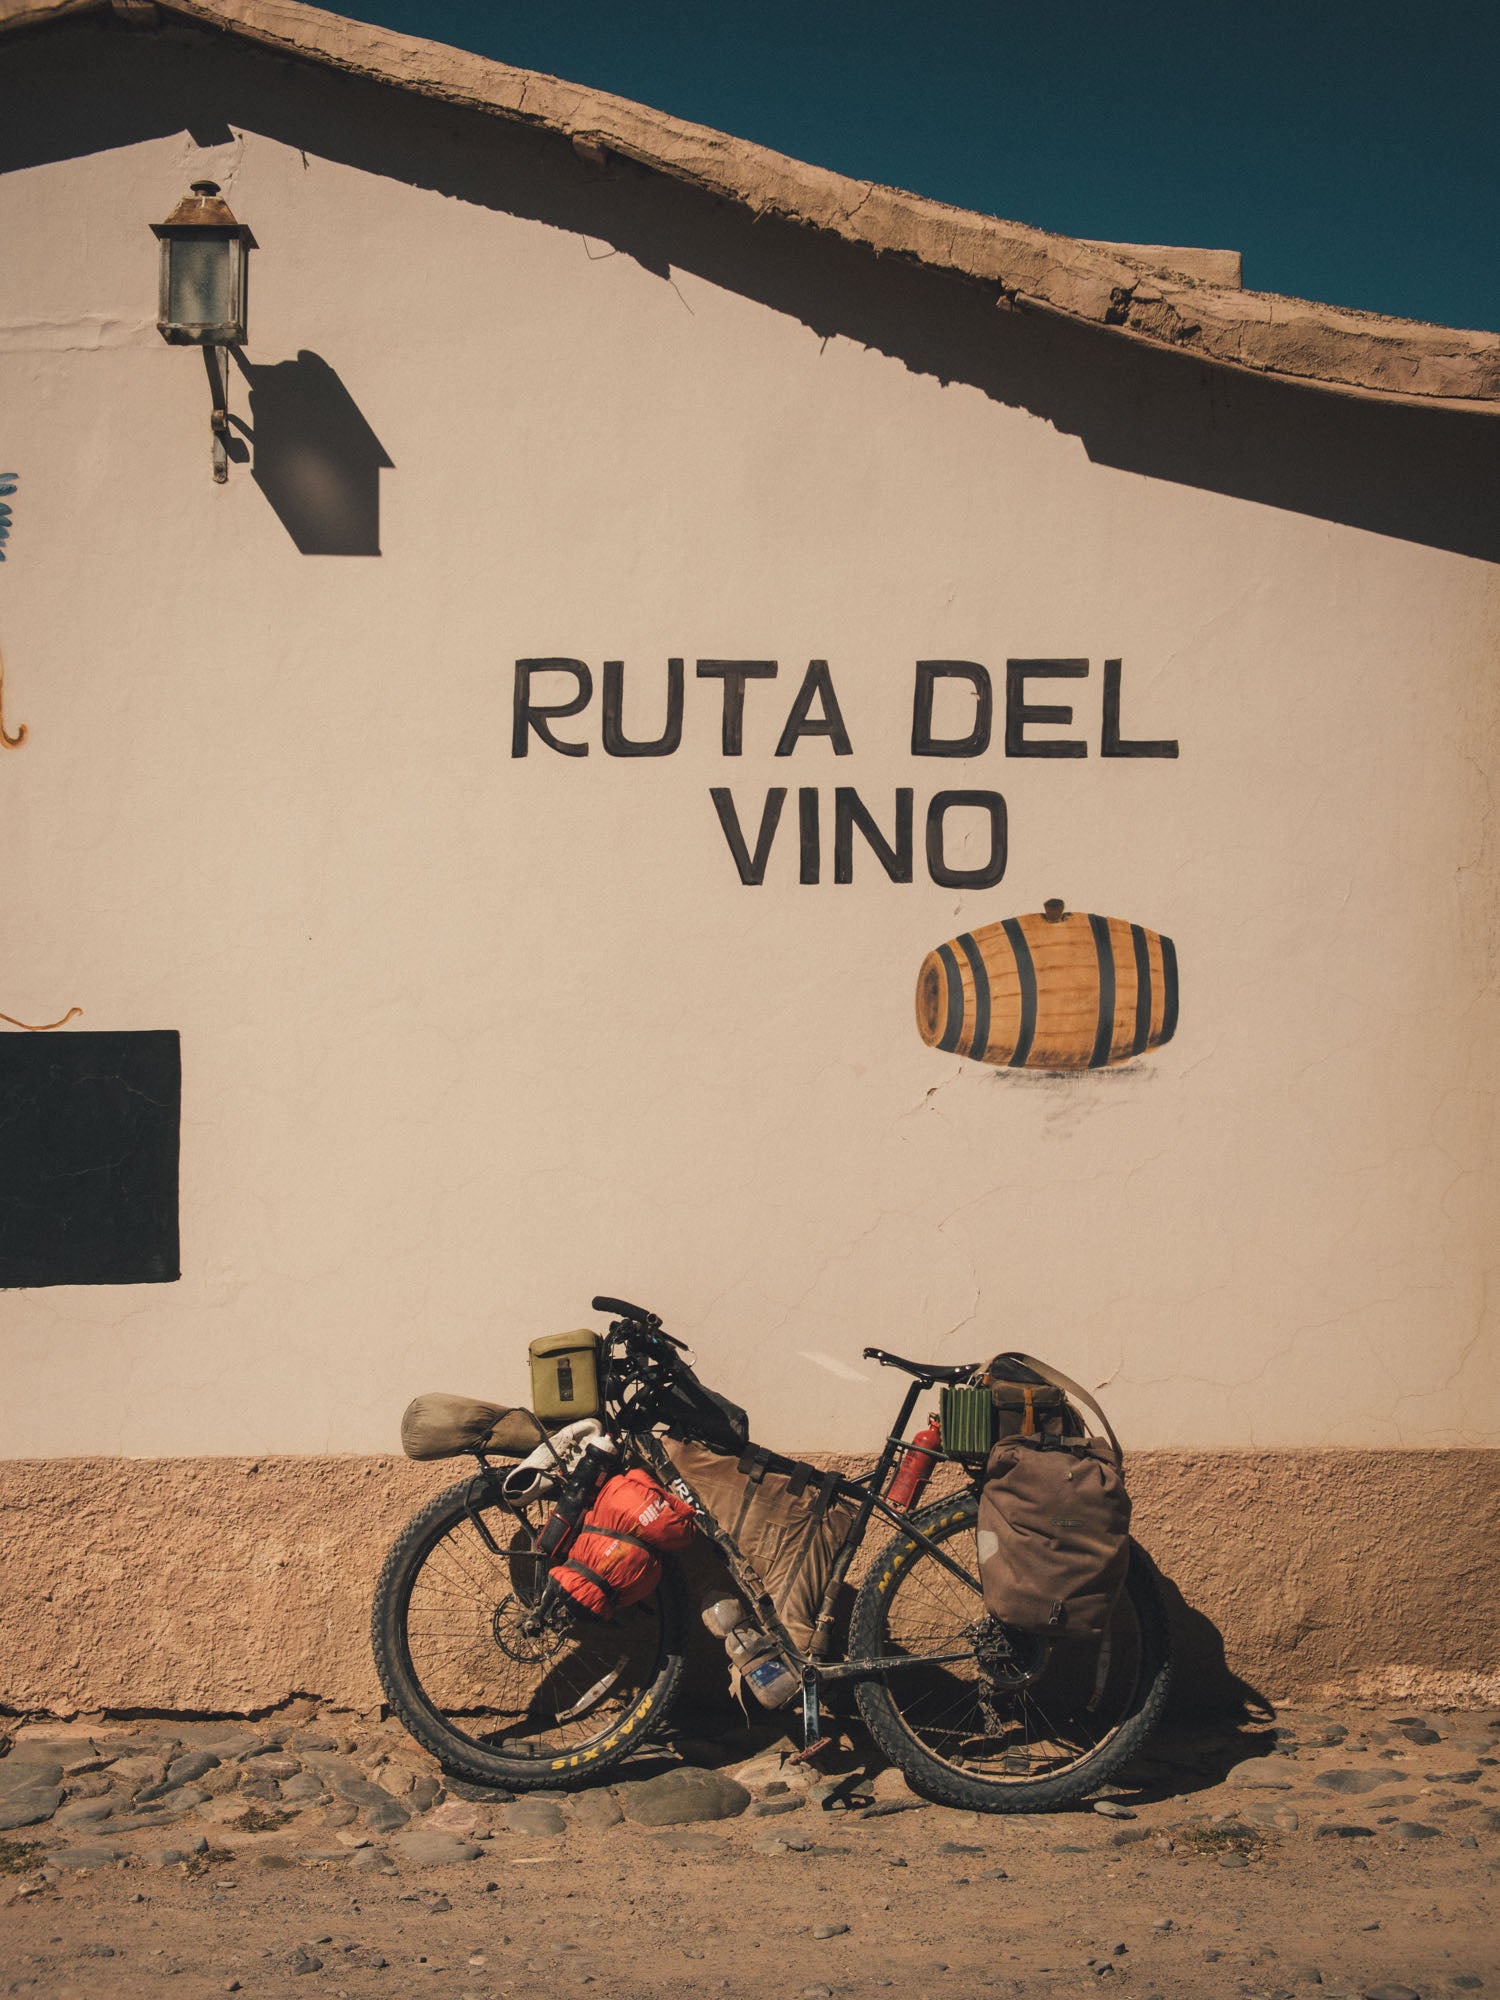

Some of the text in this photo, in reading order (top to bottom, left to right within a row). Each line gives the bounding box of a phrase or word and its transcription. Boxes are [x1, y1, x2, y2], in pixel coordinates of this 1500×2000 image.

[512, 658, 1179, 758] RUTA DEL
[709, 787, 1007, 890] VINO
[551, 1694, 653, 1770] MAXXIS
